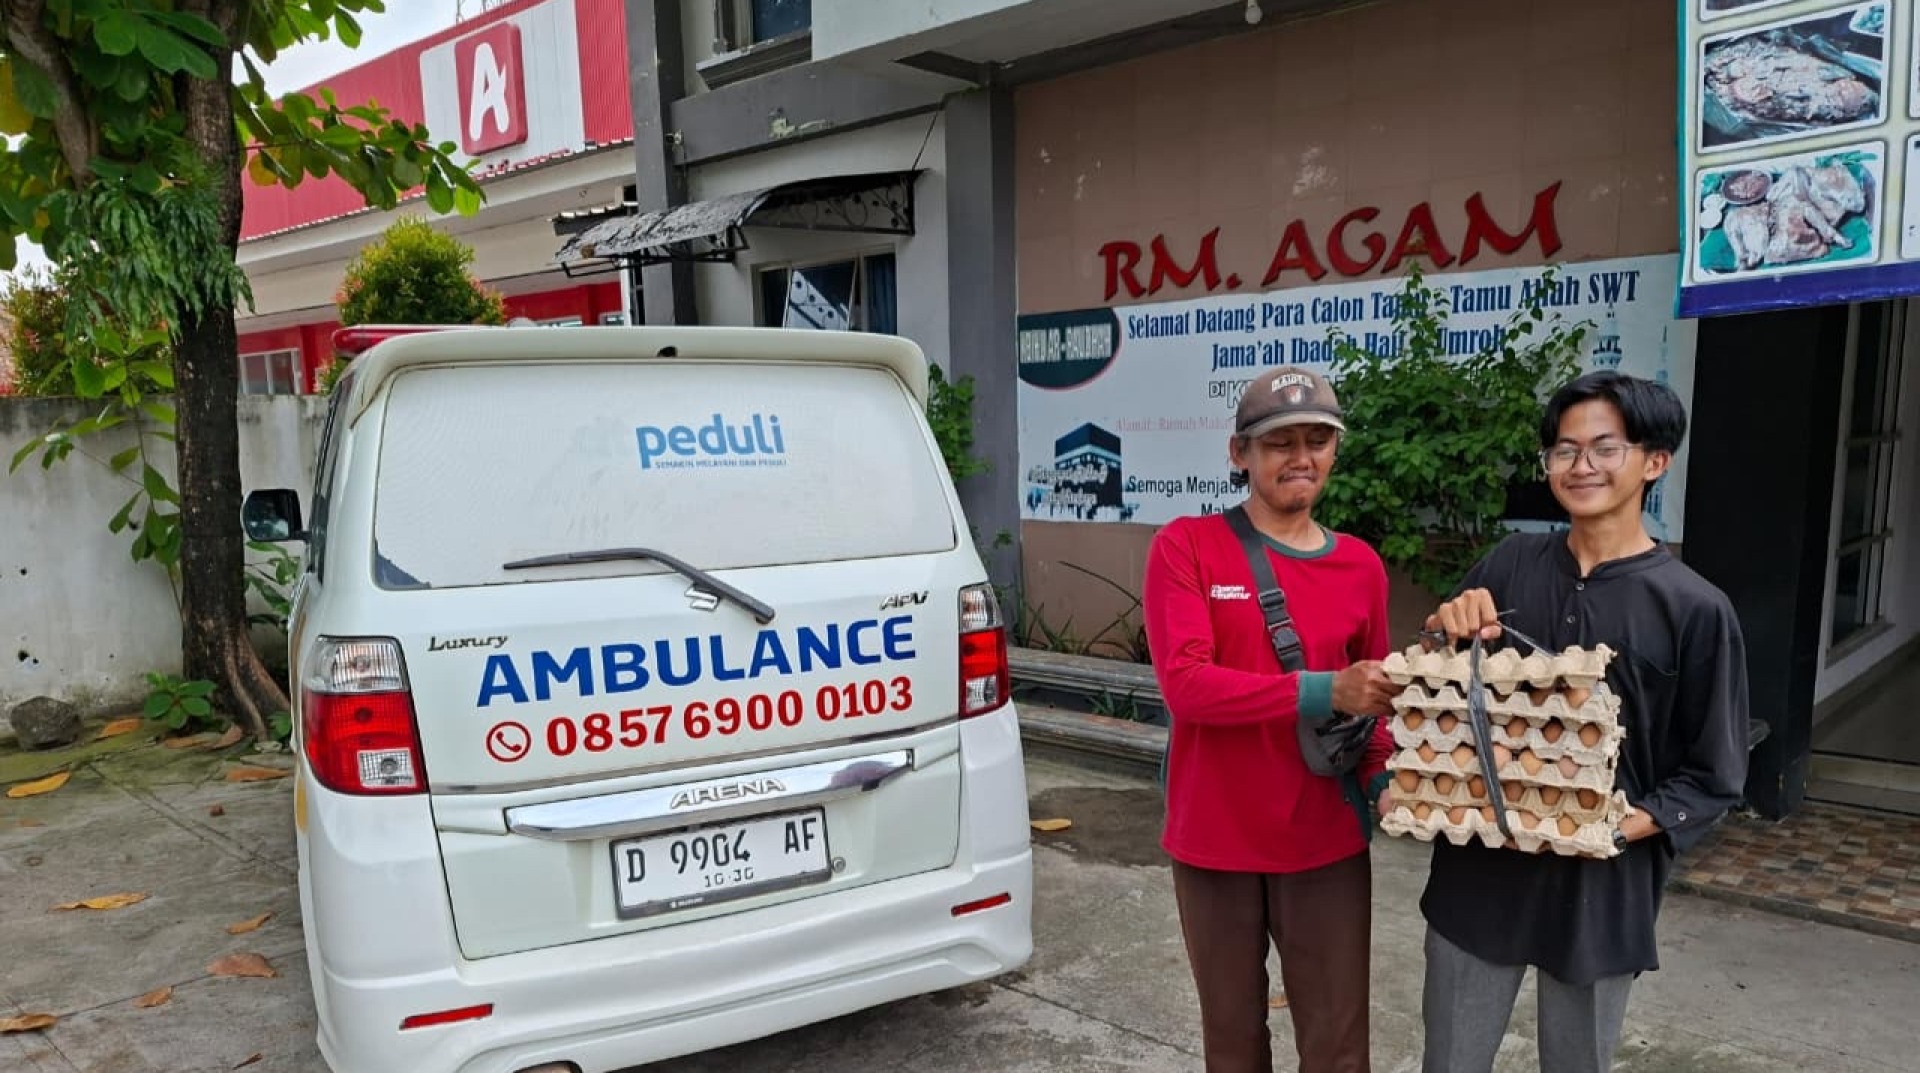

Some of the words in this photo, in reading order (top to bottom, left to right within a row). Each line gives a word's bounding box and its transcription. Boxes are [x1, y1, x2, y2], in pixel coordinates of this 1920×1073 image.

[1098, 226, 1242, 301] RM.
[1260, 180, 1563, 287] AGAM
[1128, 311, 1190, 339] Selamat
[1196, 304, 1255, 333] Datang
[1262, 302, 1305, 328] Para
[1311, 296, 1363, 325] Calon
[1450, 284, 1511, 314] Tamu
[1588, 271, 1640, 304] SWT
[1212, 338, 1285, 371] Jama'ah
[635, 413, 785, 469] peduli
[1126, 475, 1183, 498] Semoga
[880, 591, 929, 610] APV
[428, 635, 509, 652] Luxury
[477, 615, 916, 707] AMBULANCE
[546, 704, 673, 757] 0857
[683, 690, 804, 740] 6900
[815, 676, 914, 722] 0103
[670, 777, 787, 810] ARENA
[626, 847, 646, 883] D
[670, 828, 751, 874] 9904
[784, 817, 817, 855] AF
